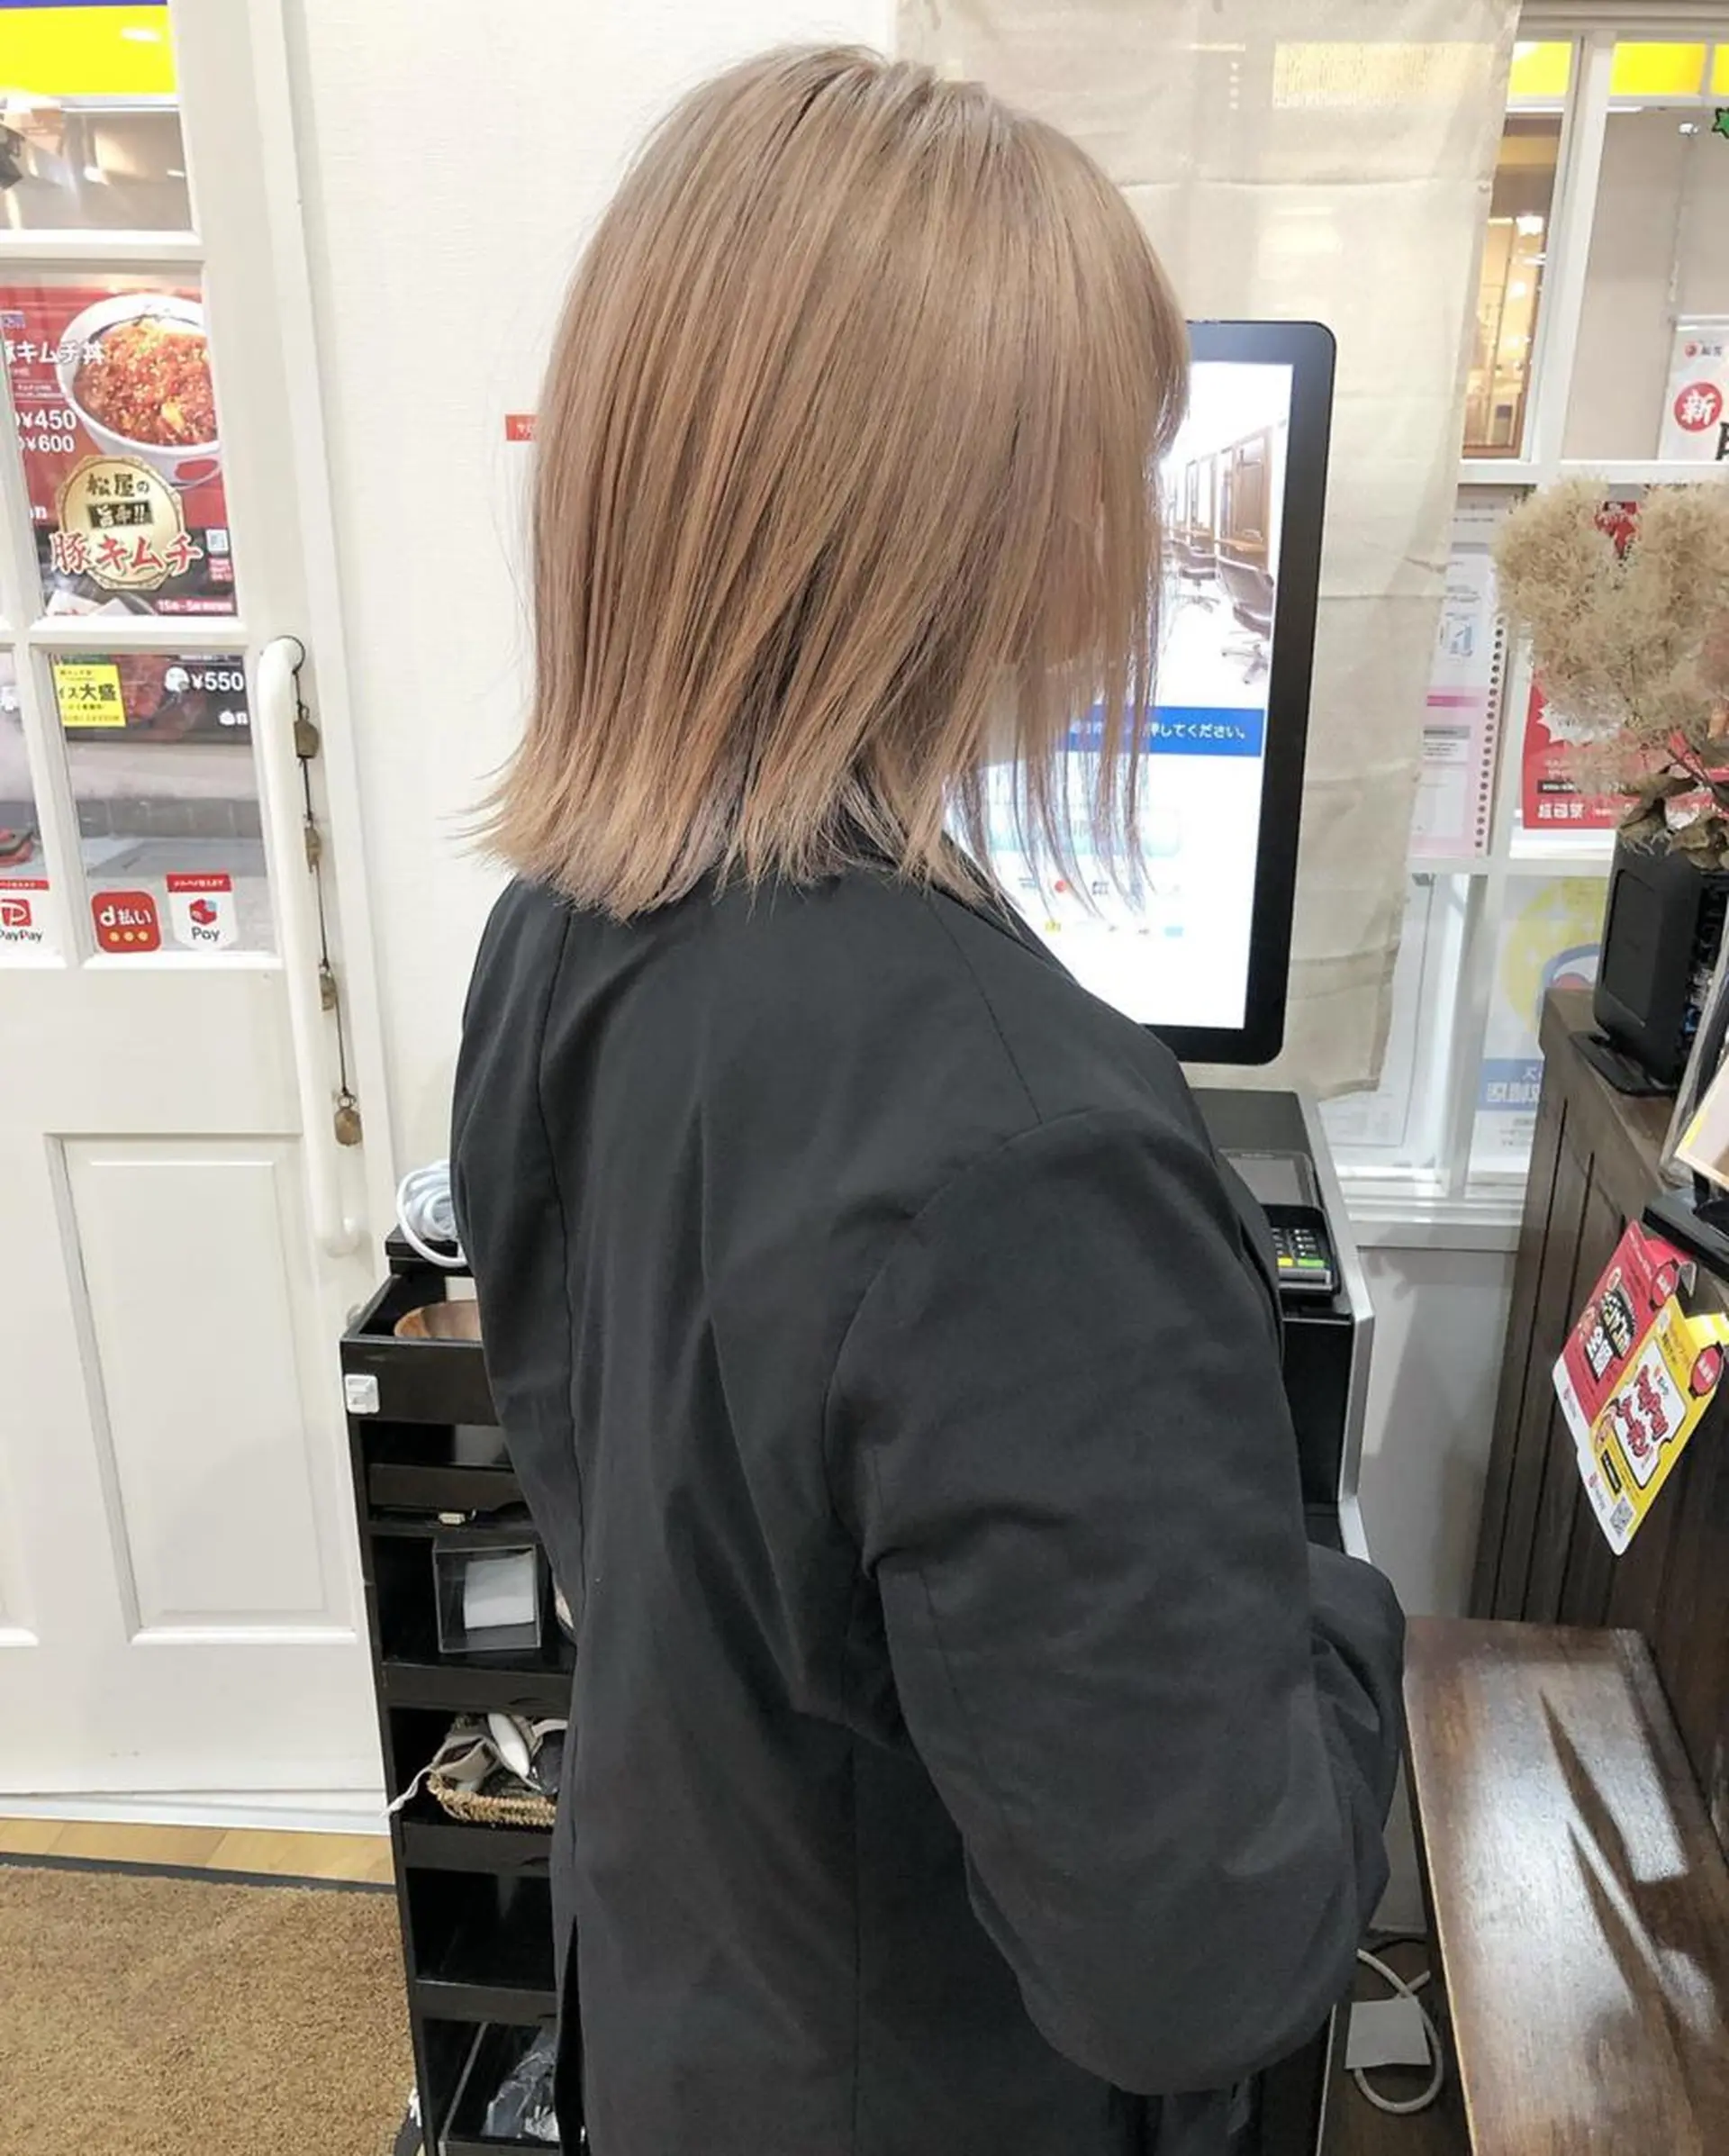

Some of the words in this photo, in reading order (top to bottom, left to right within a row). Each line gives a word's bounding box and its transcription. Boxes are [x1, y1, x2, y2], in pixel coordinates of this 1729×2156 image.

[1680, 387, 1717, 426] 新
[20, 409, 77, 430] ¥450
[26, 435, 76, 453] ¥600
[86, 473, 150, 497] 松屋の
[50, 531, 204, 576] 豚キムチ
[190, 671, 245, 692] ¥550
[99, 905, 153, 928] d払い
[191, 926, 221, 942] Pay
